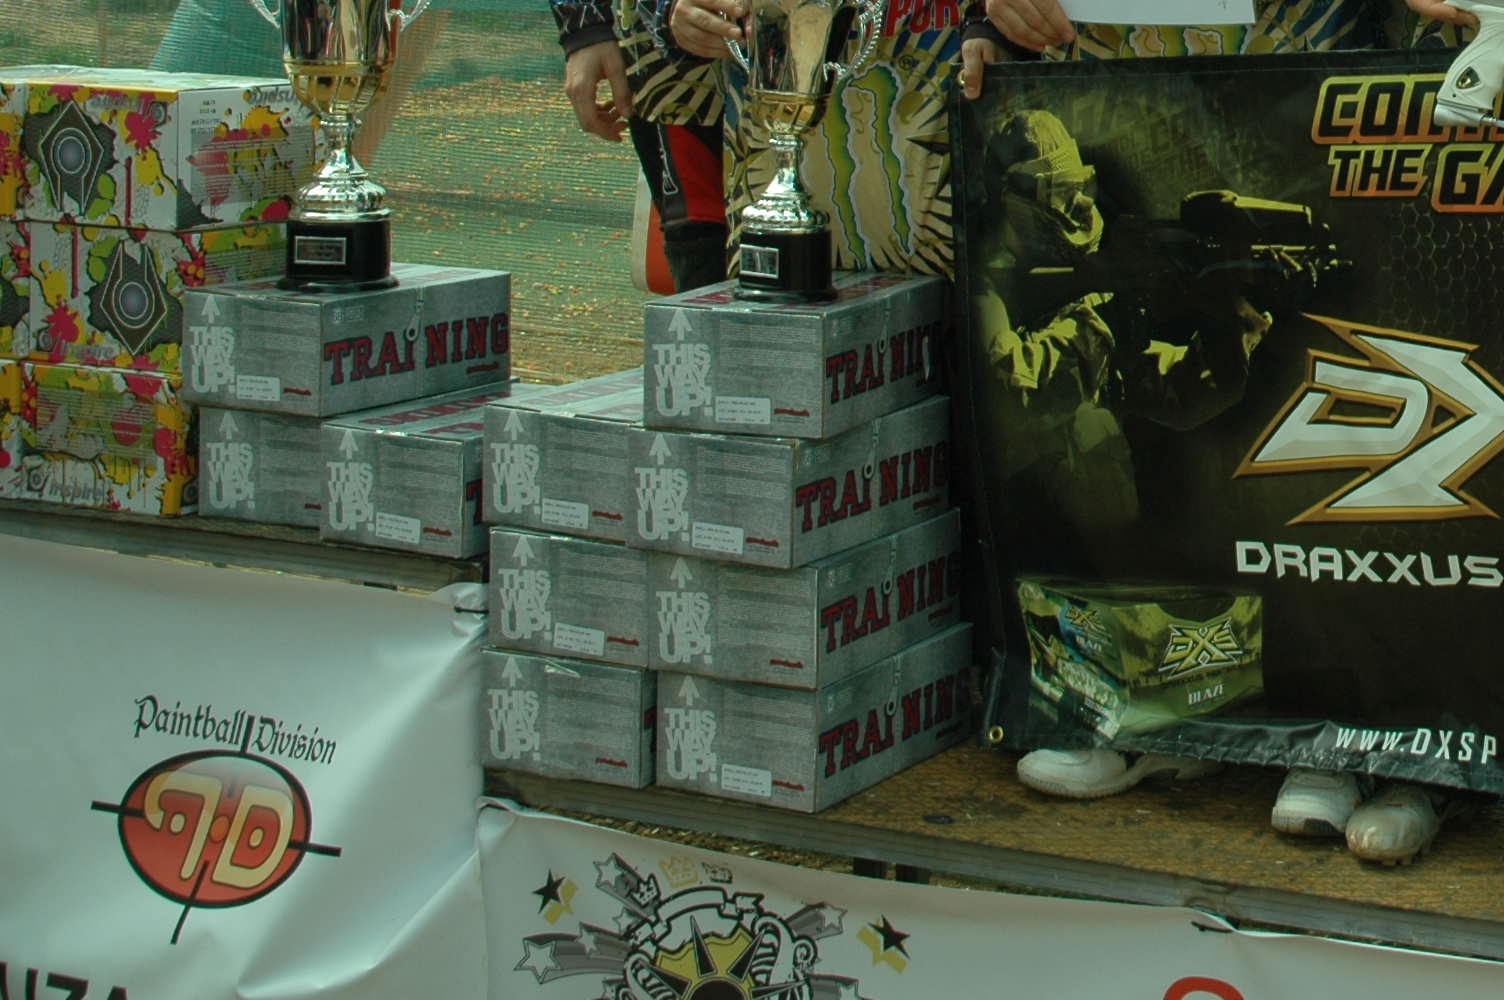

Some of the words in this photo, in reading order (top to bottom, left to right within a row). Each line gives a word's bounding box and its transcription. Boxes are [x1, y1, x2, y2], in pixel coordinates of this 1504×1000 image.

[1328, 143, 1433, 197] THE
[190, 326, 234, 347] THIS
[323, 312, 509, 386] TRAINING
[653, 344, 711, 367] THIS
[207, 442, 253, 464] THIS
[490, 442, 540, 466] THIS
[327, 462, 374, 484] THIS
[635, 467, 688, 491] THIS
[1235, 540, 1504, 588] DRAXXUS
[499, 568, 550, 590] THIS
[656, 591, 710, 614] THIS
[488, 689, 539, 712] THIS
[134, 693, 244, 747] Paintball
[250, 714, 337, 765] Division
[664, 708, 716, 731] THIS
